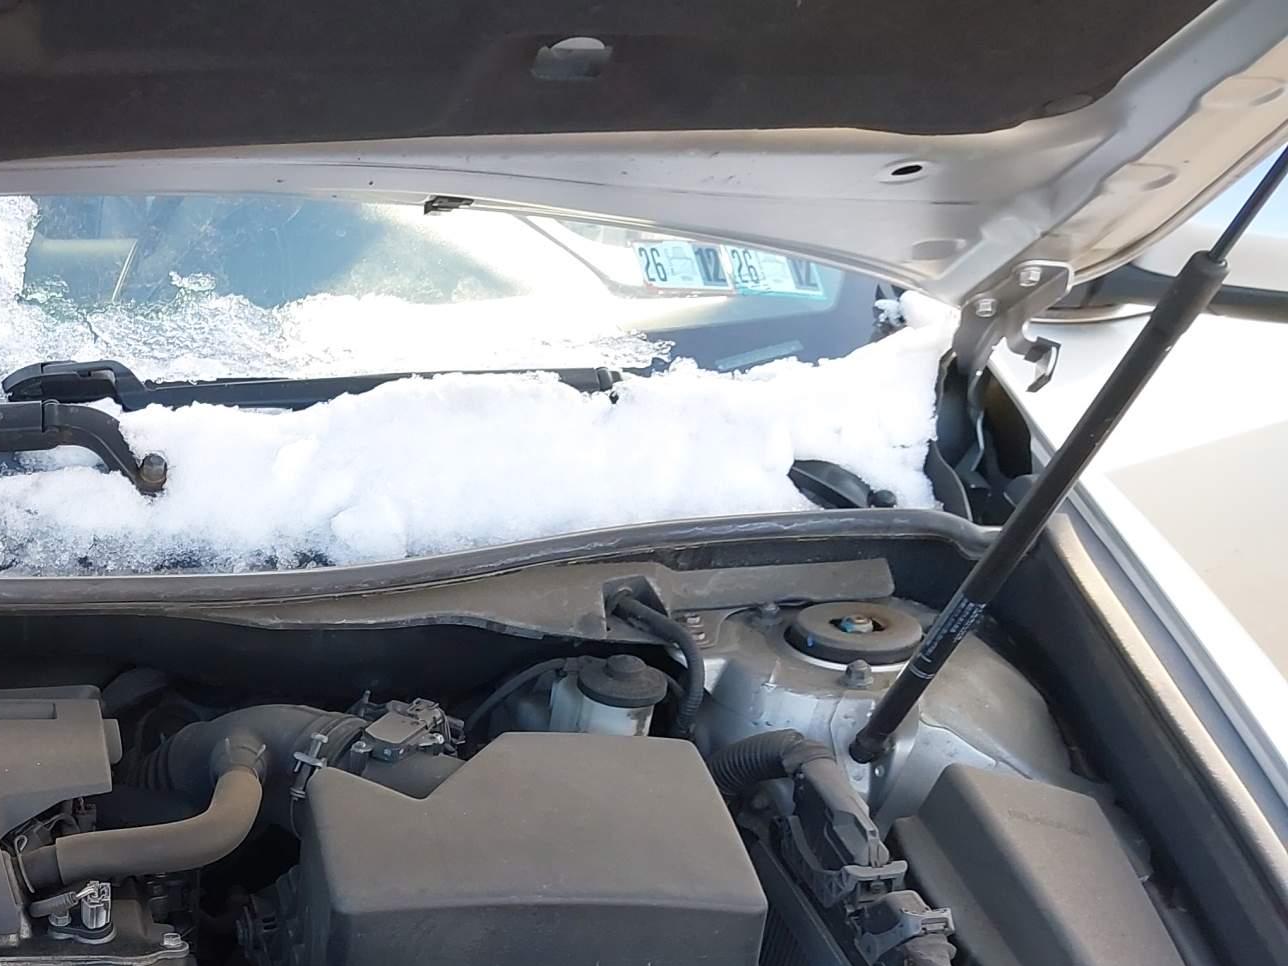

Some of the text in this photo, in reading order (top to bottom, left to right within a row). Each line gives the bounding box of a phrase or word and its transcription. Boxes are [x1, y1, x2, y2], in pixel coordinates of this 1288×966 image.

[639, 247, 727, 283] 26 12
[731, 249, 760, 284] 26
